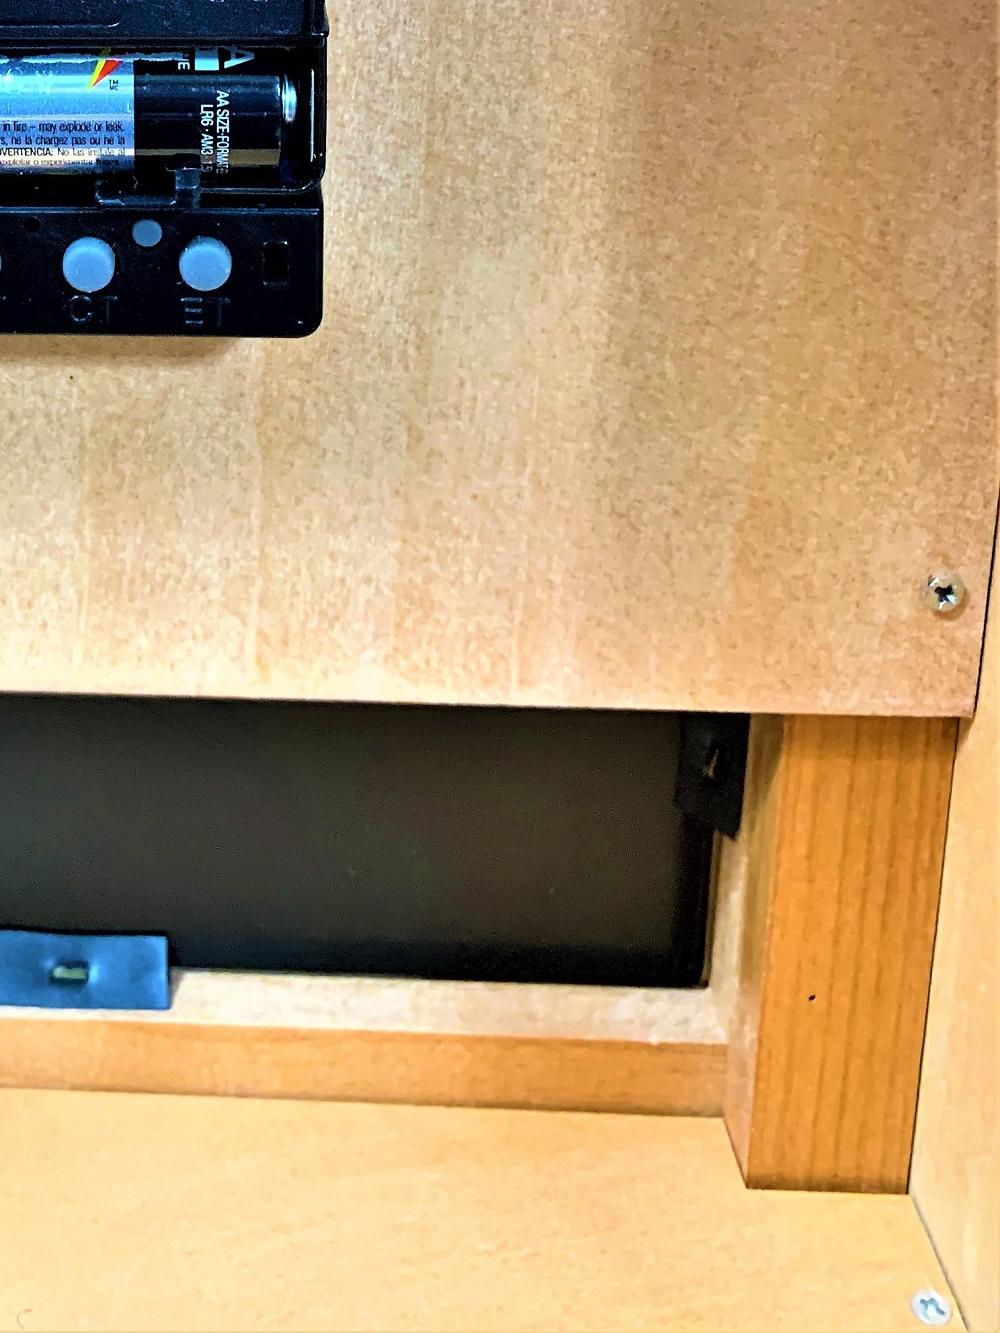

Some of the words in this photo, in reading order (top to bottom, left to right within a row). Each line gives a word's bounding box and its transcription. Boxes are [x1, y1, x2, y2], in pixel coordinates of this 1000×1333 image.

[216, 90, 230, 108] AA
[200, 104, 214, 127] LR6
[2, 121, 11, 132] in
[13, 121, 27, 132] fire
[38, 122, 57, 134] may
[59, 121, 92, 134] explode
[94, 122, 102, 132] or
[11, 136, 22, 145] ne
[25, 135, 33, 145] la
[35, 135, 68, 147] chargez
[71, 136, 87, 147] pas
[89, 137, 101, 145] ou
[57, 148, 70, 156] No
[68, 294, 118, 325] CT
[179, 296, 231, 327] ET
